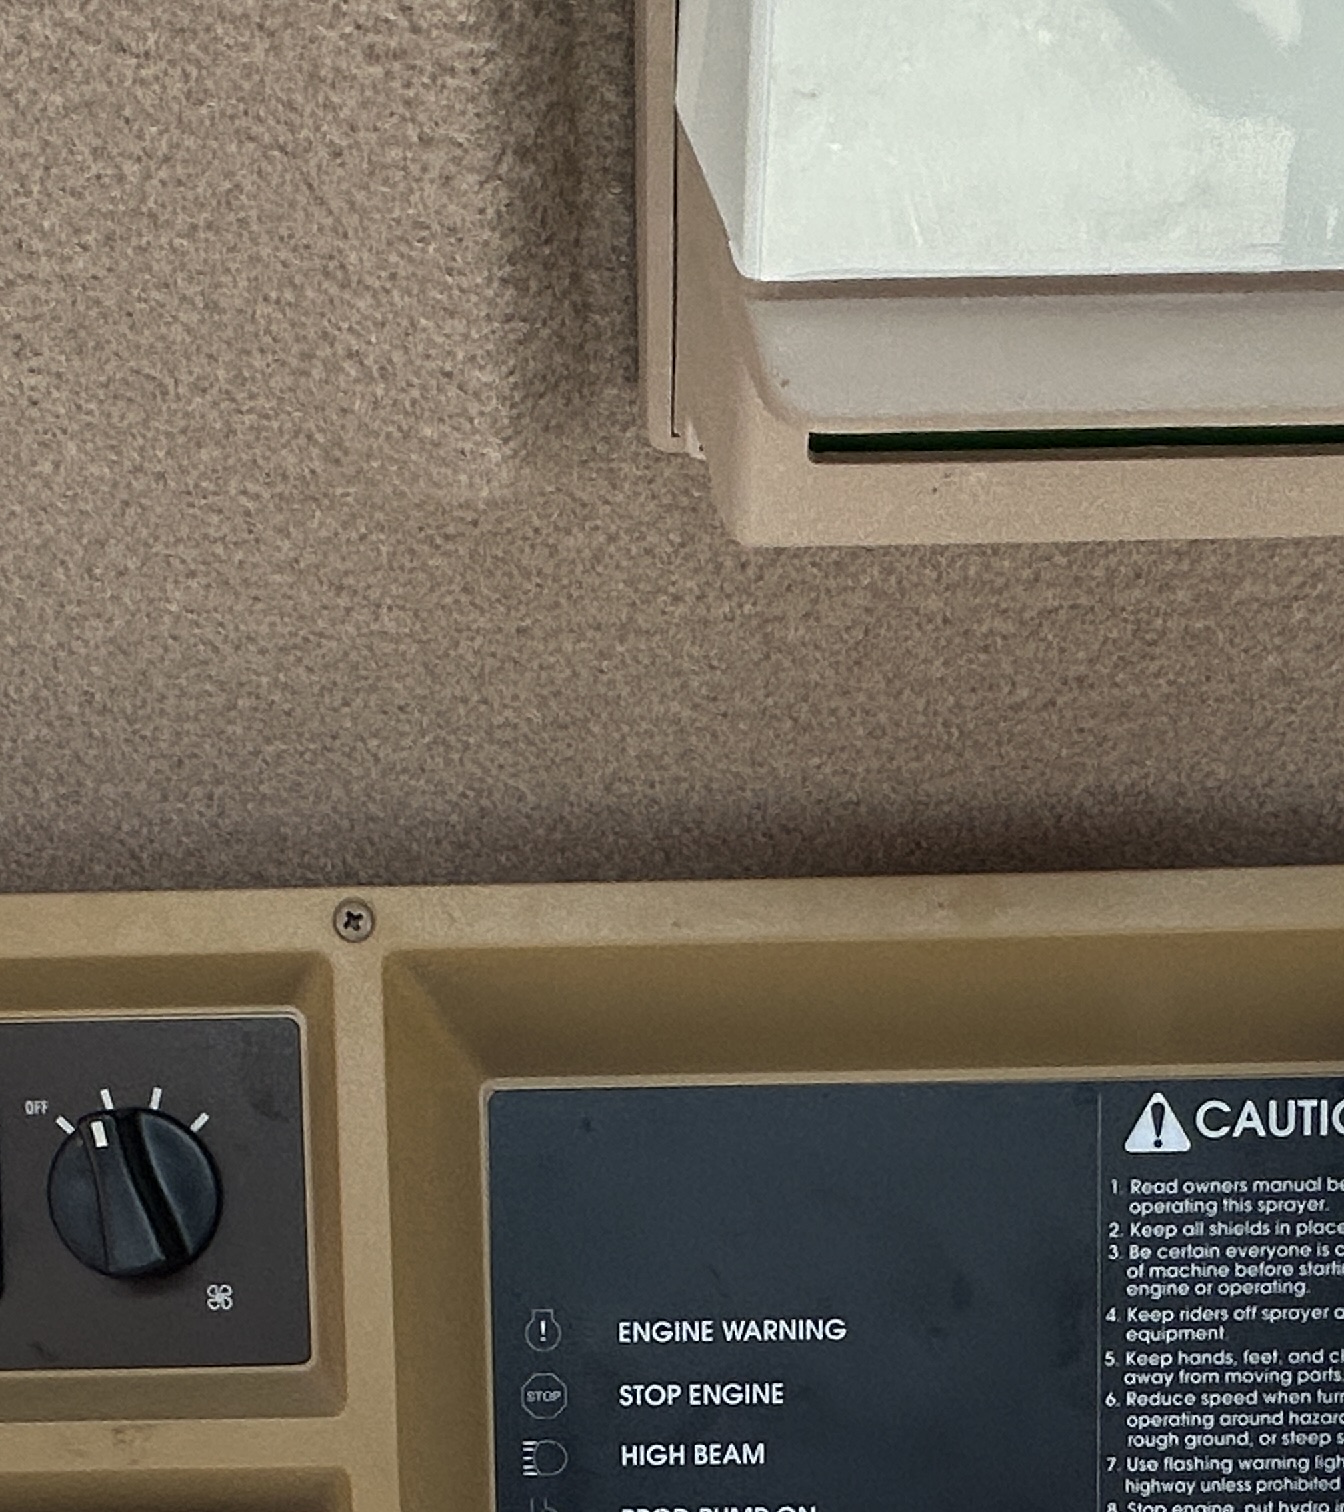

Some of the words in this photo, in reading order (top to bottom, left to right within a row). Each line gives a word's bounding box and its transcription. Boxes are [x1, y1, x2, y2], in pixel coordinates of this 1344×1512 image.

[25, 1100, 48, 1116] OFF
[1130, 1179, 1178, 1194] Read
[1182, 1178, 1247, 1193] owners
[1253, 1177, 1321, 1192] manual
[1129, 1200, 1218, 1216] operating
[1223, 1199, 1252, 1213] this
[1258, 1199, 1329, 1215] sprayer.
[1130, 1222, 1178, 1239] Keep
[1182, 1222, 1204, 1236] all
[1209, 1221, 1270, 1236] shields
[1275, 1220, 1290, 1235] in
[1129, 1244, 1152, 1259] Be
[1156, 1244, 1220, 1258] certain
[1226, 1242, 1312, 1259] everyone
[1317, 1242, 1330, 1256] is
[1127, 1264, 1144, 1279] of
[1149, 1263, 1229, 1278] machine
[1234, 1262, 1293, 1277] before
[1127, 1281, 1189, 1300] engine
[1194, 1281, 1214, 1296] or
[1218, 1280, 1310, 1298] operating.
[618, 1321, 714, 1342] ENGINE
[722, 1319, 847, 1341] WARNING
[1125, 1351, 1172, 1368] Keep
[1178, 1350, 1238, 1366] hands,
[1243, 1350, 1283, 1365] feet,
[1288, 1349, 1324, 1364] and
[1124, 1370, 1173, 1387] away
[1179, 1369, 1220, 1384] from
[1225, 1368, 1292, 1386] moving
[1297, 1368, 1344, 1384] parts.
[527, 1390, 561, 1402] STOP
[619, 1384, 681, 1406] STOP
[688, 1383, 784, 1405] ENGINE
[621, 1444, 685, 1466] HIGH
[694, 1443, 765, 1464] BEAM
